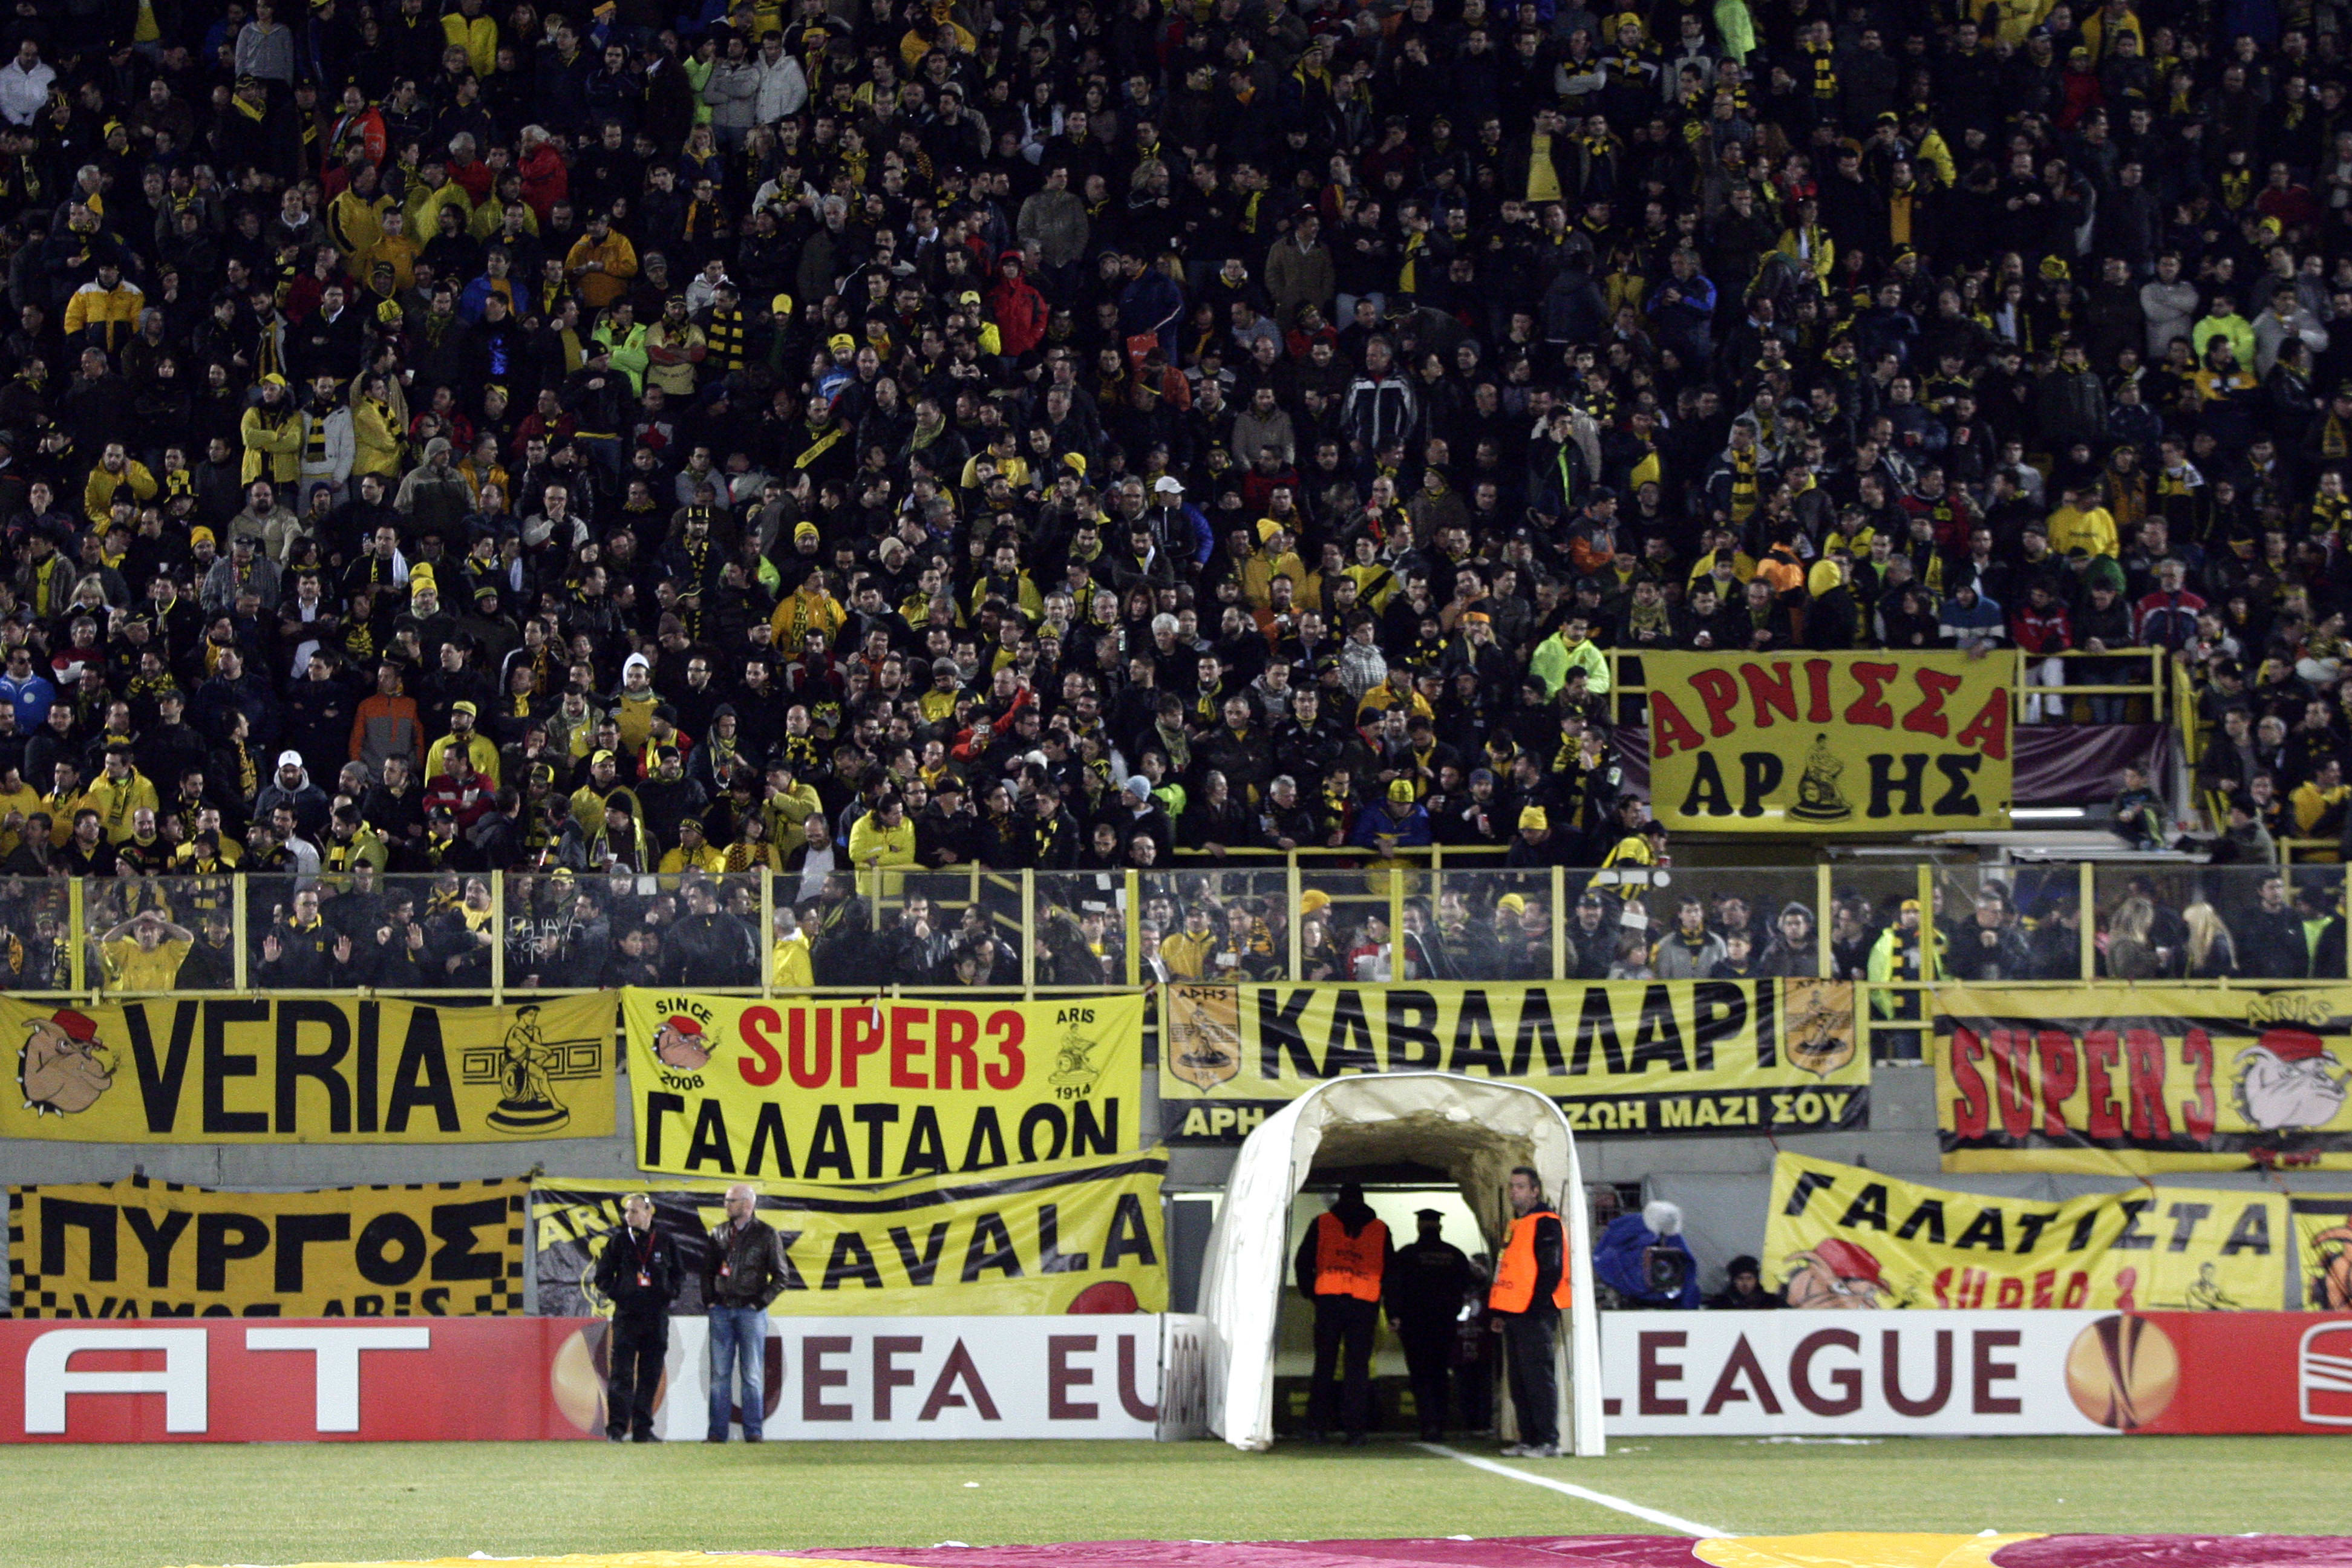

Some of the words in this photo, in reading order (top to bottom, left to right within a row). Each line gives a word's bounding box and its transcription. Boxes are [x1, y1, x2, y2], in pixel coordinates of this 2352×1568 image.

[1649, 659, 2008, 759] ΑΡΝΙΣΣΑ
[656, 998, 714, 1025] SINCE
[1057, 1008, 1095, 1024] ARIS
[1258, 979, 1777, 1079] ΚΑΒΑΛΛΑΡΙ
[2245, 994, 2333, 1027] ARIS
[123, 1000, 462, 1134] VERIA
[660, 1070, 705, 1091] 2008
[1056, 1083, 1091, 1100] 1914
[1951, 1027, 2172, 1140] SUPER
[2183, 1027, 2216, 1142] 3
[1562, 1101, 1647, 1131] ΖΩΗ
[1659, 1096, 1759, 1128] ΜΑΖΙ
[1770, 1093, 1850, 1124] ΣΟΥ
[39, 1197, 508, 1293] ΠΥΡΓΟΣ
[538, 1194, 656, 1252] ARI
[1785, 1171, 2272, 1255] ΓΑΛΑΤΙΣΤΑ
[25, 1327, 430, 1434] AT
[1603, 1328, 2022, 1417] EAGUE
